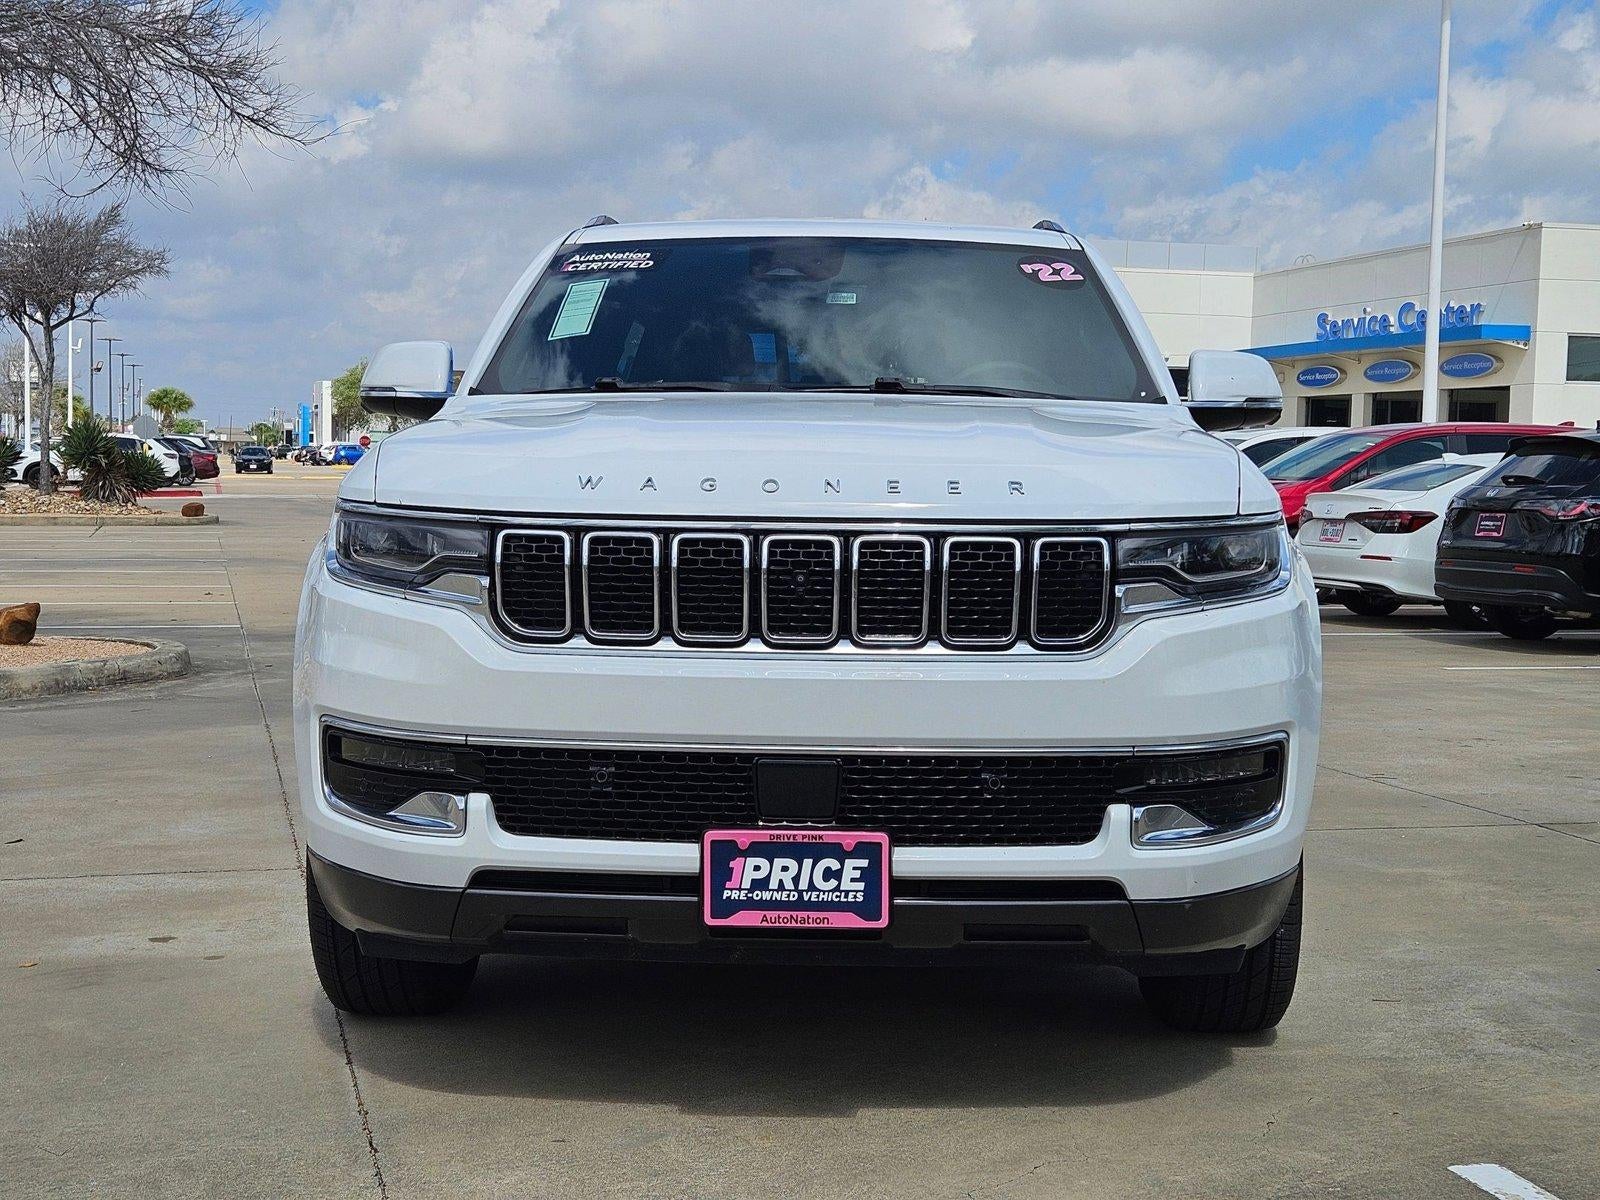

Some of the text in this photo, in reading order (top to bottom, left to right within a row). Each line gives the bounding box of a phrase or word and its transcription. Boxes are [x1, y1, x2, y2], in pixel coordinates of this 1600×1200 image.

[570, 251, 651, 261] AutoNation
[1316, 308, 1391, 341] Service
[1443, 360, 1492, 371] Service Reception
[1299, 371, 1337, 381] Service Reception
[1366, 366, 1409, 376] Service Reception
[578, 474, 1025, 496] WAGONEER
[769, 833, 824, 842] DRIVE PINK
[723, 890, 864, 902] PRE-OWNED VEHICLES
